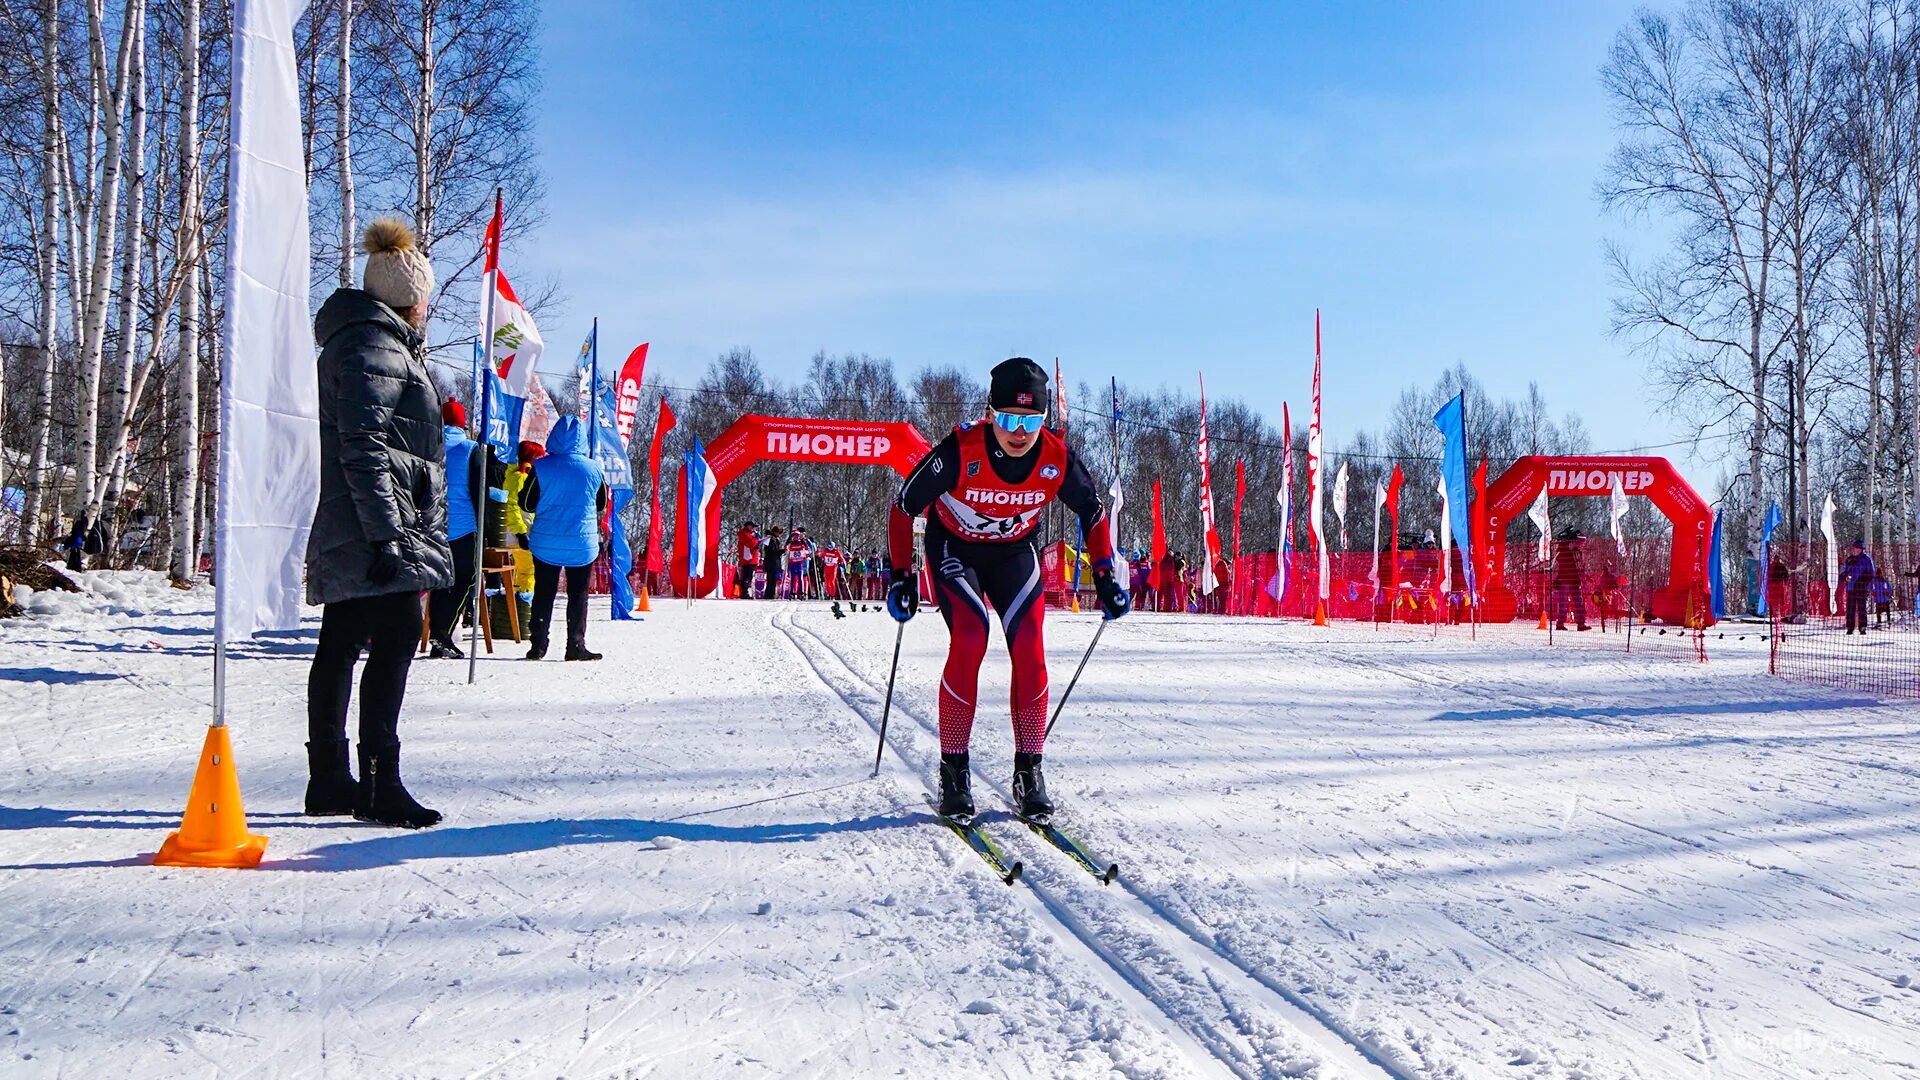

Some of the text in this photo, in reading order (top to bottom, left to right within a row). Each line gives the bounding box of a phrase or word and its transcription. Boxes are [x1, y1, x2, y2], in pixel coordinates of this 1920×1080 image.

[766, 431, 891, 458] ПИОНЕР
[1548, 470, 1655, 490] ПИОНЕР
[964, 489, 1046, 506] ПИОНЕР
